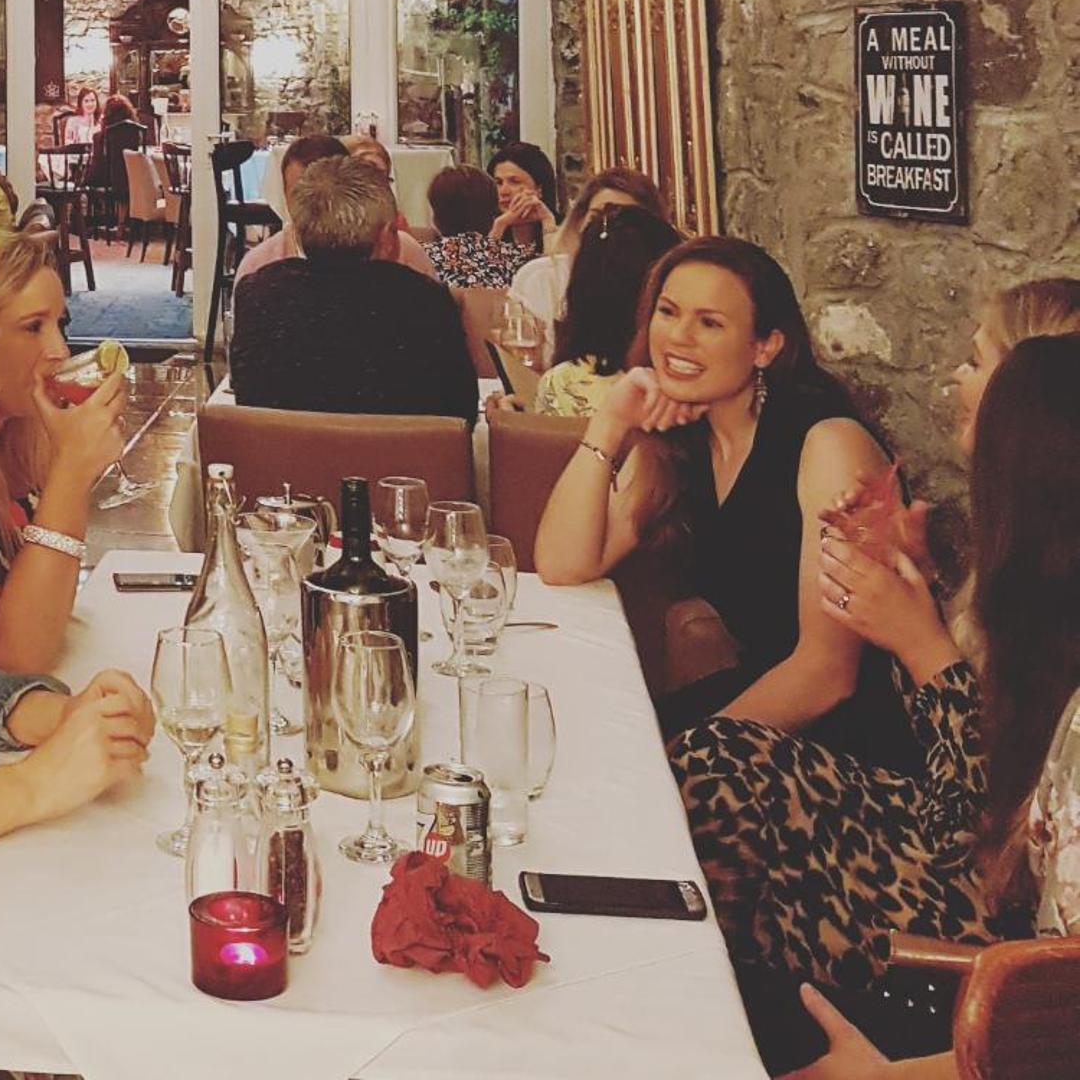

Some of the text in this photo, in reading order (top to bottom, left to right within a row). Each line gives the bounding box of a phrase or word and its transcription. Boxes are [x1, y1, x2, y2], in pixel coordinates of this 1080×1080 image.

[866, 26, 951, 52] A MEAL
[881, 55, 936, 71] WITHOUT
[866, 74, 951, 128] WINE
[867, 130, 951, 161] IS CALLED
[867, 163, 951, 192] BREAKFAST
